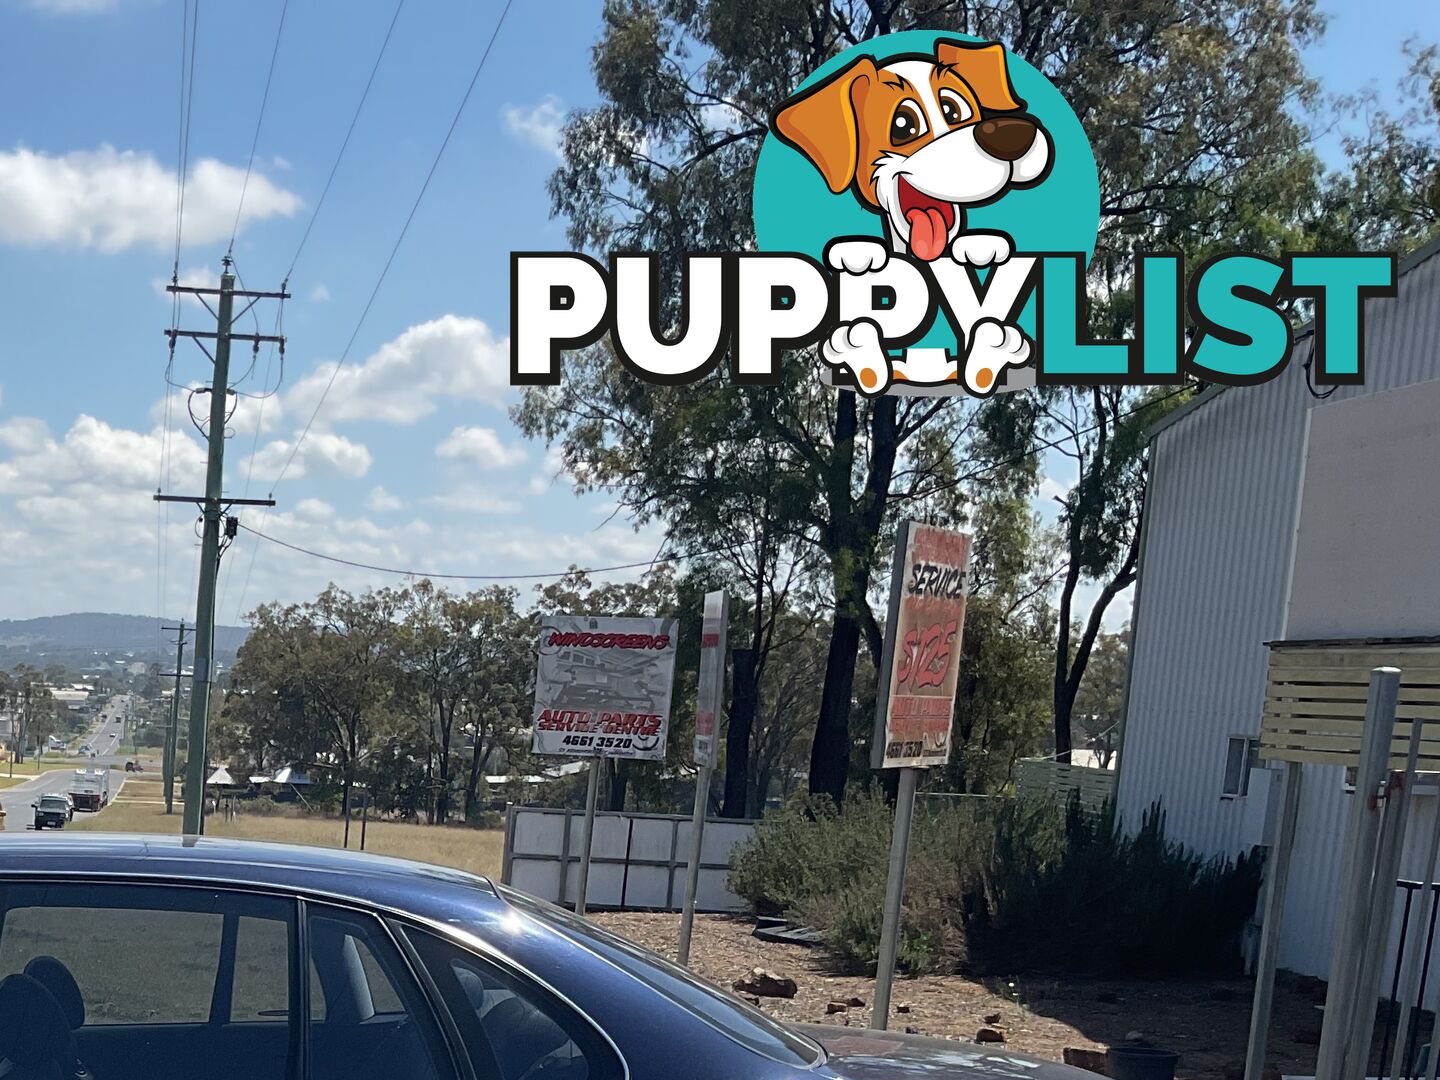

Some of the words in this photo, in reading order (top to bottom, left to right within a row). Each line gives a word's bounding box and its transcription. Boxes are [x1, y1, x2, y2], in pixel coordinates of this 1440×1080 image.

[908, 563, 966, 599] SERVICE
[548, 632, 670, 650] WINDSCREENS
[537, 709, 593, 724] AUTO
[596, 712, 663, 731] PARTS
[537, 721, 600, 734] SERVICE
[562, 735, 594, 748] 4661
[596, 736, 632, 749] 3520
